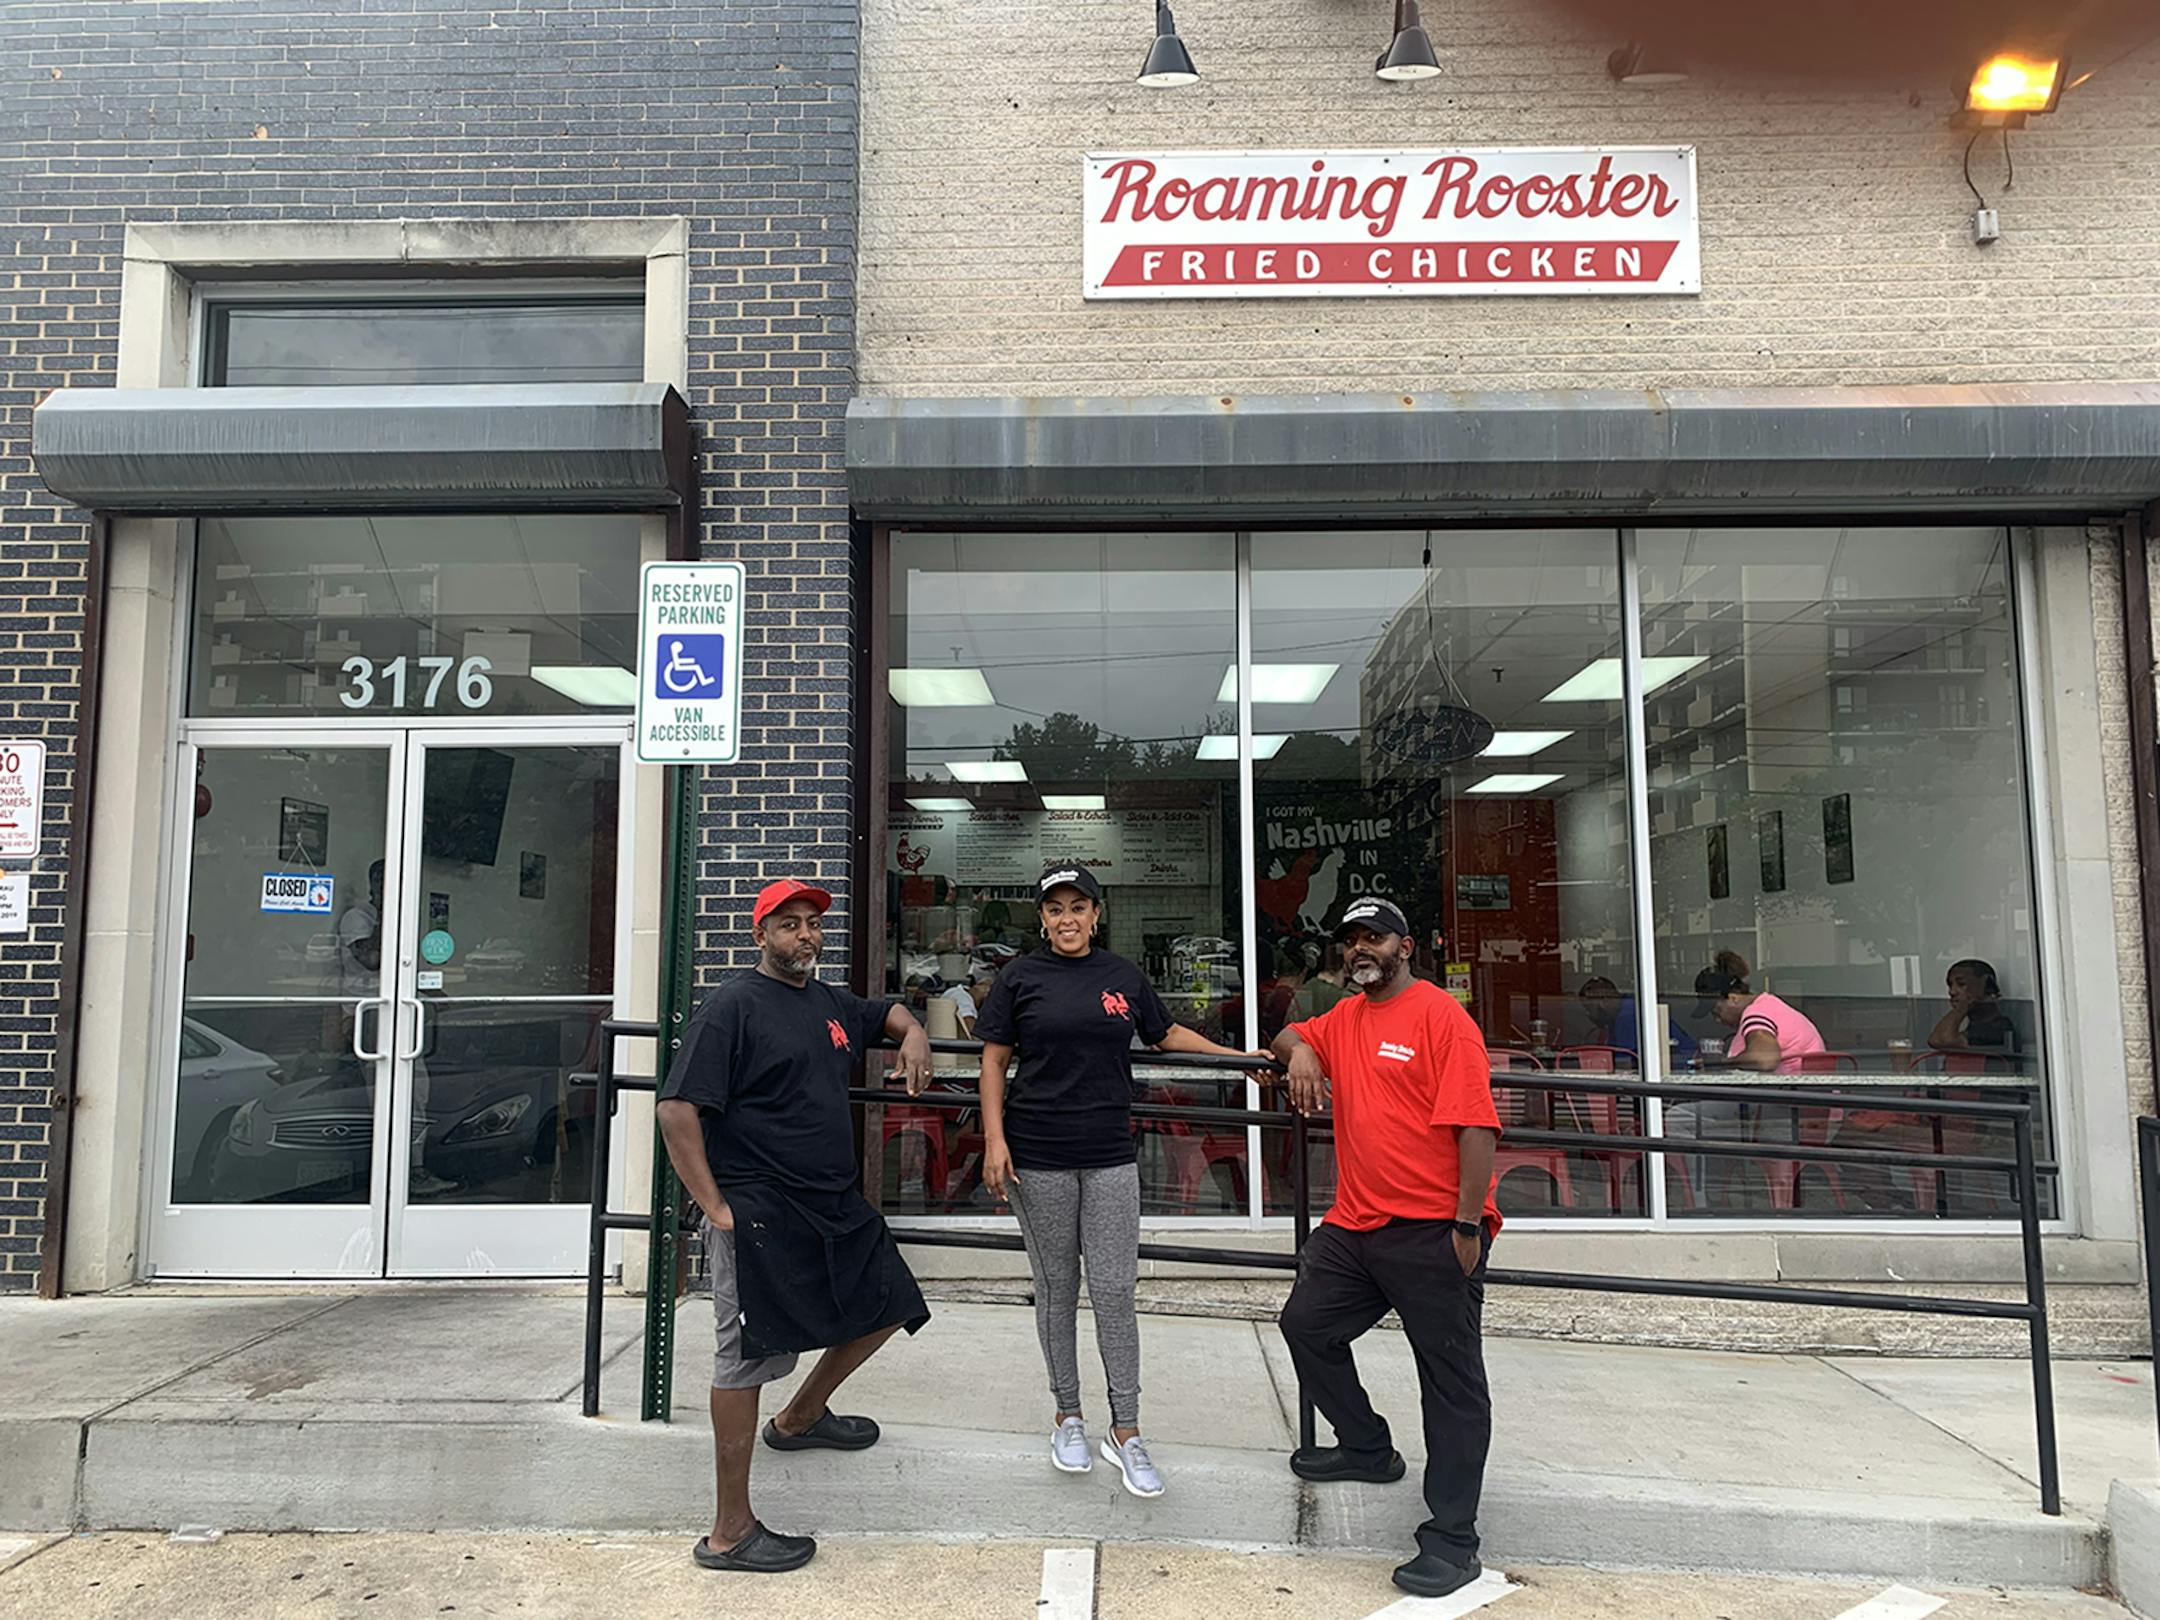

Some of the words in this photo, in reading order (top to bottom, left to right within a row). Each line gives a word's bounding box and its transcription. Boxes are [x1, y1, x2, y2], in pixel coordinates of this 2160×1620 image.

[1100, 159, 1407, 237] Roaming
[1422, 156, 1679, 219] Rooster
[1142, 249, 1321, 281] FRIED
[1368, 246, 1641, 280] CHICKEN
[652, 584, 733, 603] RESERVED
[658, 606, 726, 625] PARKING
[339, 656, 493, 709] 3176
[674, 707, 703, 723] VAN
[649, 725, 725, 741] ACCESSIBLE
[1265, 806, 1271, 817] I
[1271, 806, 1295, 817] GOT
[1297, 805, 1315, 817] MY
[1266, 816, 1392, 850] Nashville
[1360, 849, 1378, 866] IN
[265, 878, 307, 897] CLOSED
[1349, 873, 1394, 894] D.C.
